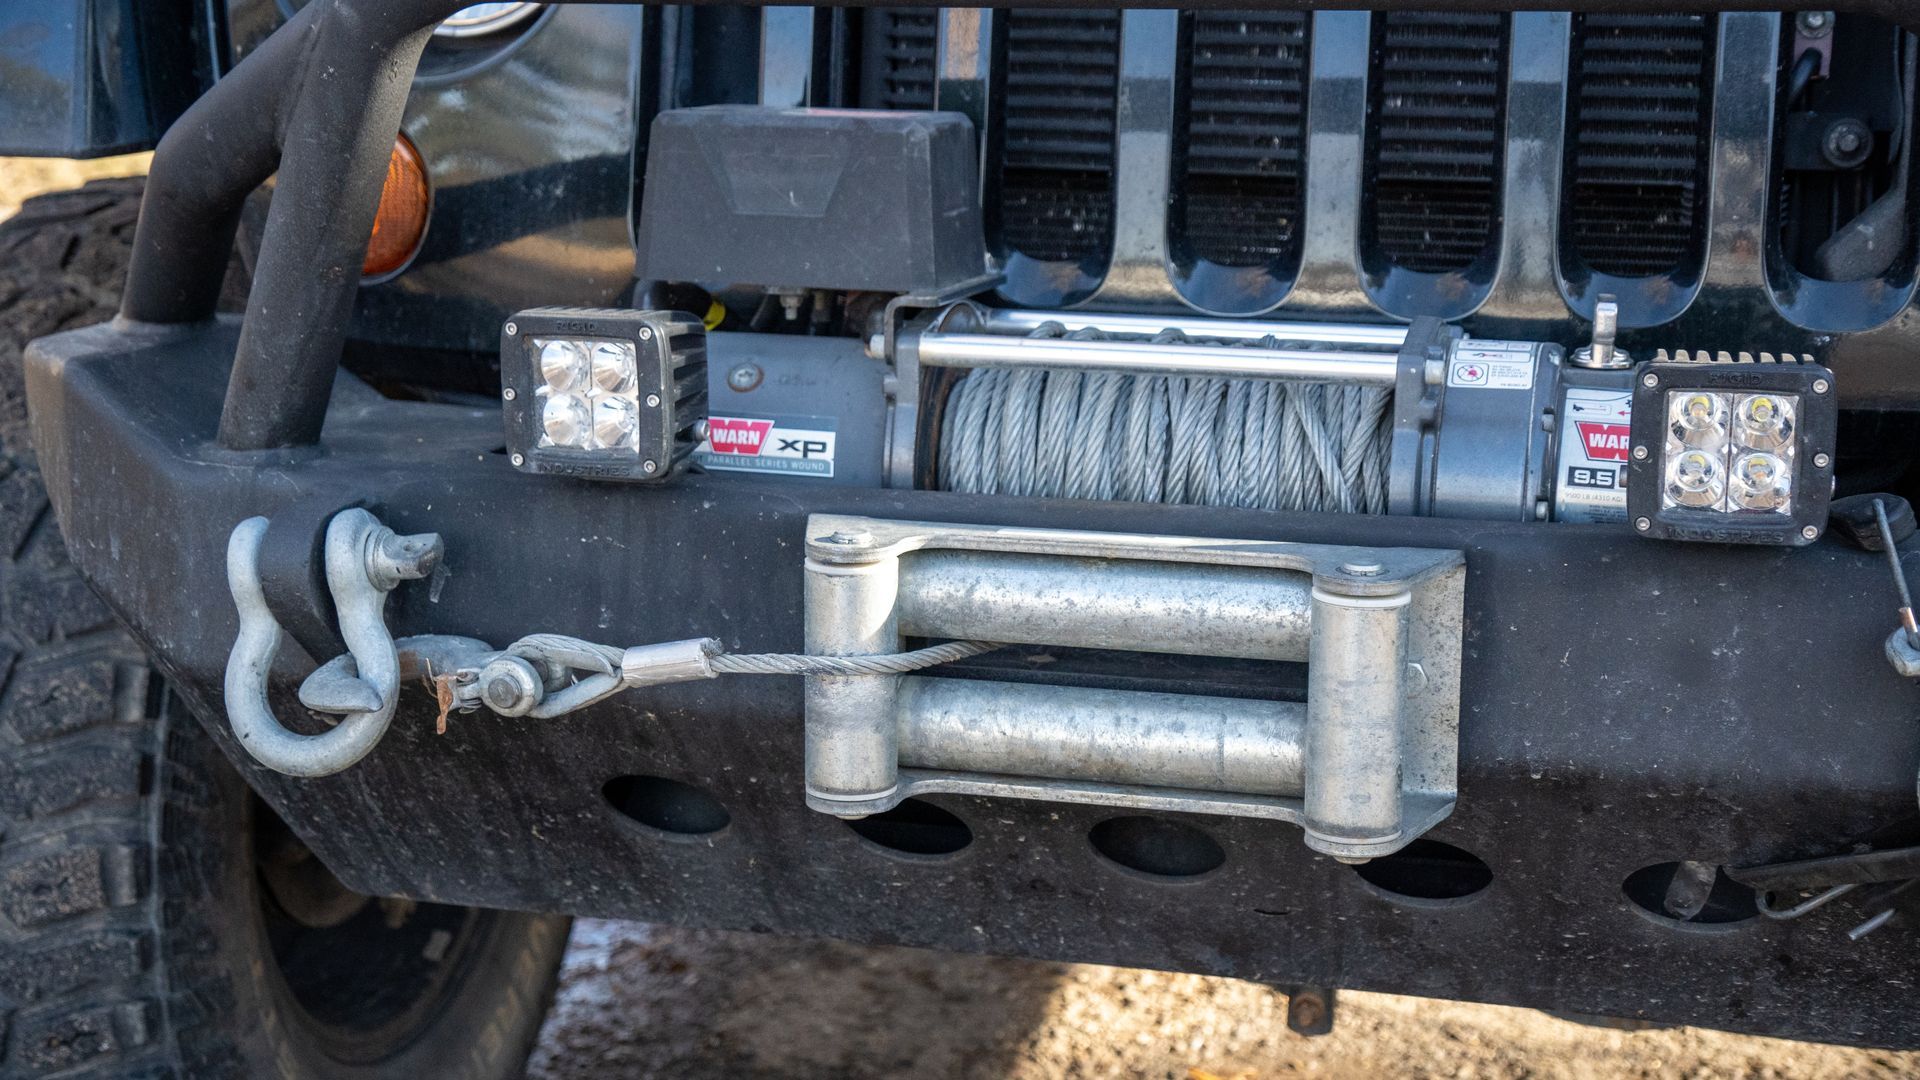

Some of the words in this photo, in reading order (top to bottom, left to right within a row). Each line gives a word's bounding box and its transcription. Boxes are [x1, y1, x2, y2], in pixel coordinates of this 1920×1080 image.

[713, 428, 760, 445] WARN
[1589, 433, 1629, 449] WAR
[777, 438, 827, 458] XP
[538, 463, 631, 477] INDUSTRIES
[708, 454, 750, 464] PARALLEL
[755, 458, 787, 468] SERIES
[791, 460, 825, 471] WOUND
[1574, 469, 1612, 486] 9.5
[1665, 527, 1784, 543] INDUSTRIES
